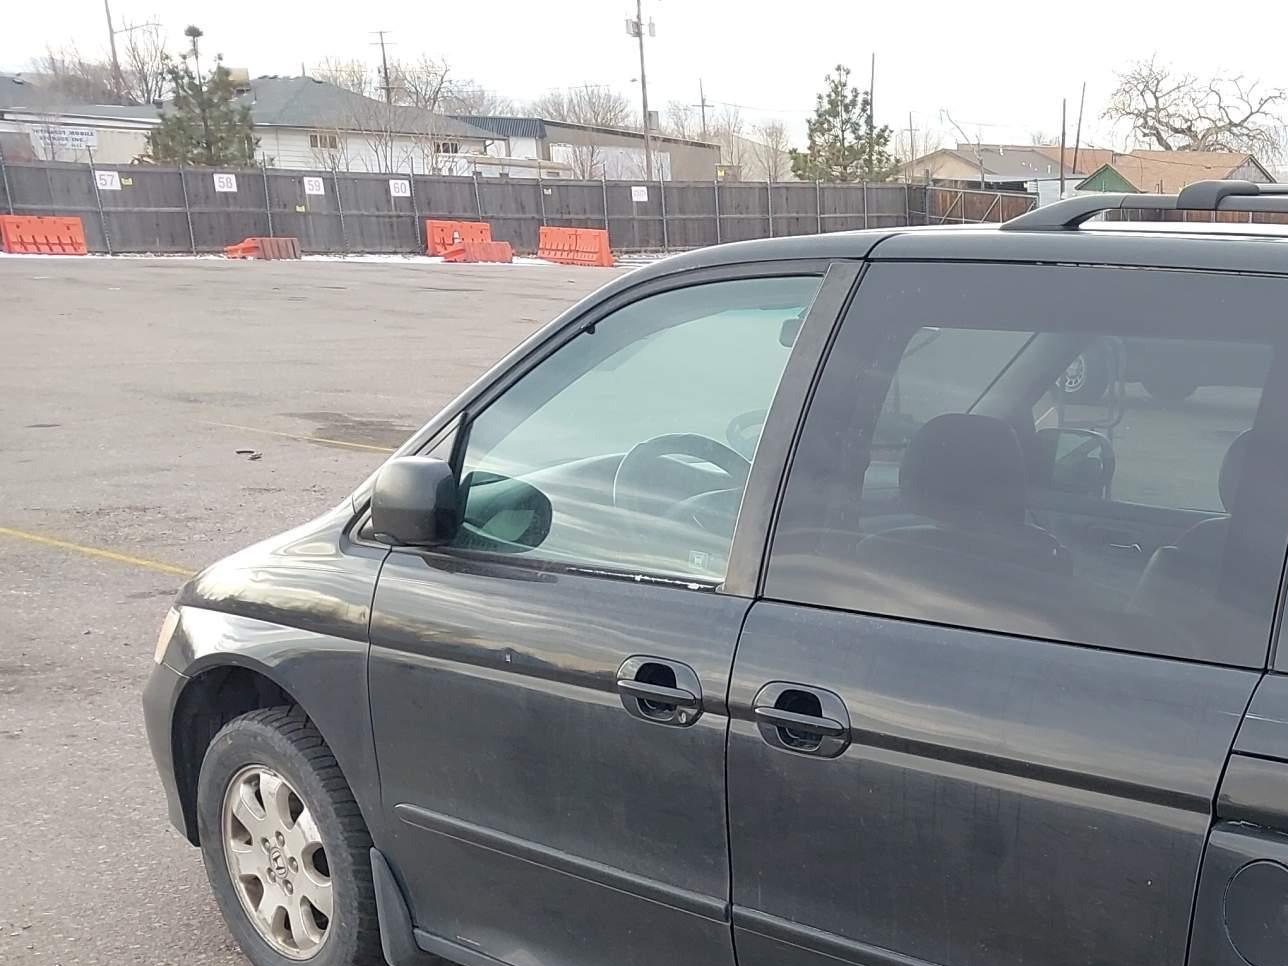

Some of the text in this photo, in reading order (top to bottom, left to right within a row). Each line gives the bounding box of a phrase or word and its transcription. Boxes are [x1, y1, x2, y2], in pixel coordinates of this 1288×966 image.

[99, 174, 114, 186] 57
[218, 176, 233, 189] 58
[307, 180, 321, 192] 59
[393, 182, 407, 194] 60
